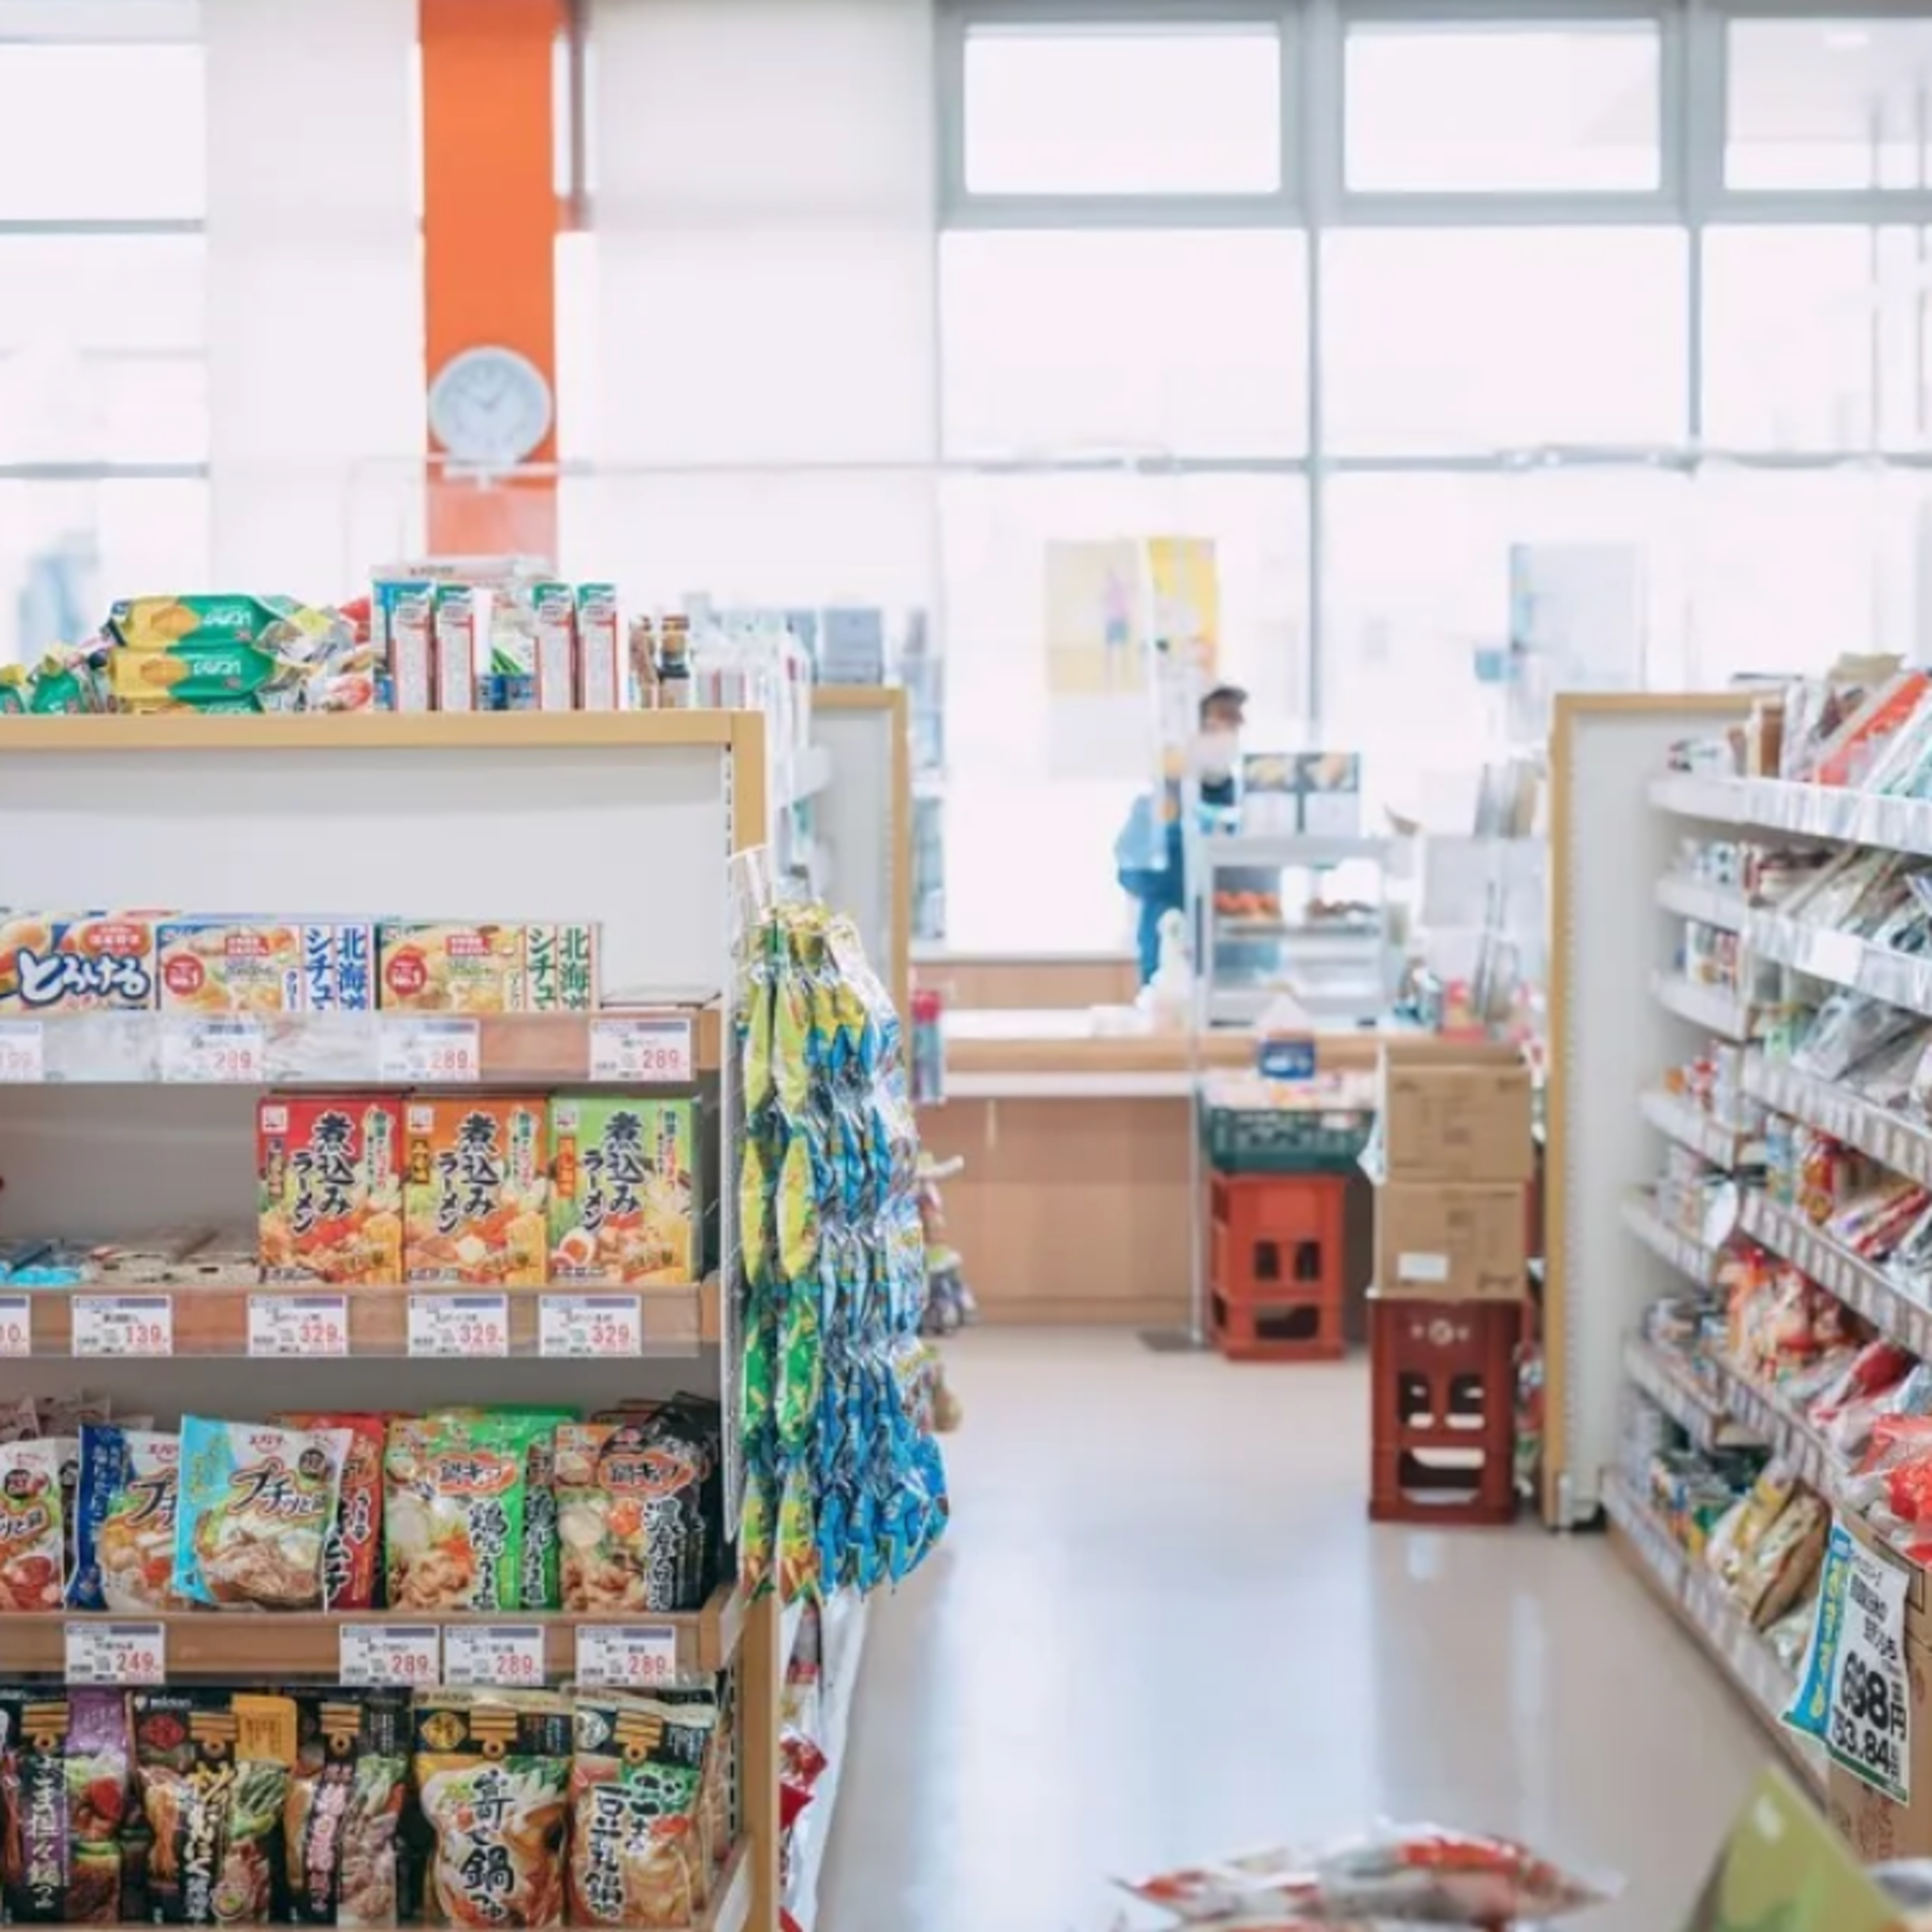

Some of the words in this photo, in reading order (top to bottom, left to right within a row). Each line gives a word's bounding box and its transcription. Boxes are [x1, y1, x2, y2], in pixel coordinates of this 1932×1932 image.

[305, 927, 333, 1010] シチュ
[528, 927, 557, 1010] シチュ
[643, 1049, 679, 1069] 289
[314, 1112, 355, 1216] 煮込み
[459, 1112, 500, 1215] 煮込み
[604, 1111, 644, 1214] 煮込み
[301, 1323, 337, 1343] 329
[460, 1323, 497, 1343] 329
[593, 1323, 630, 1343] 329
[117, 1651, 154, 1672] 249
[392, 1654, 428, 1674] 289
[497, 1654, 533, 1674] 289
[629, 1655, 665, 1674] 289
